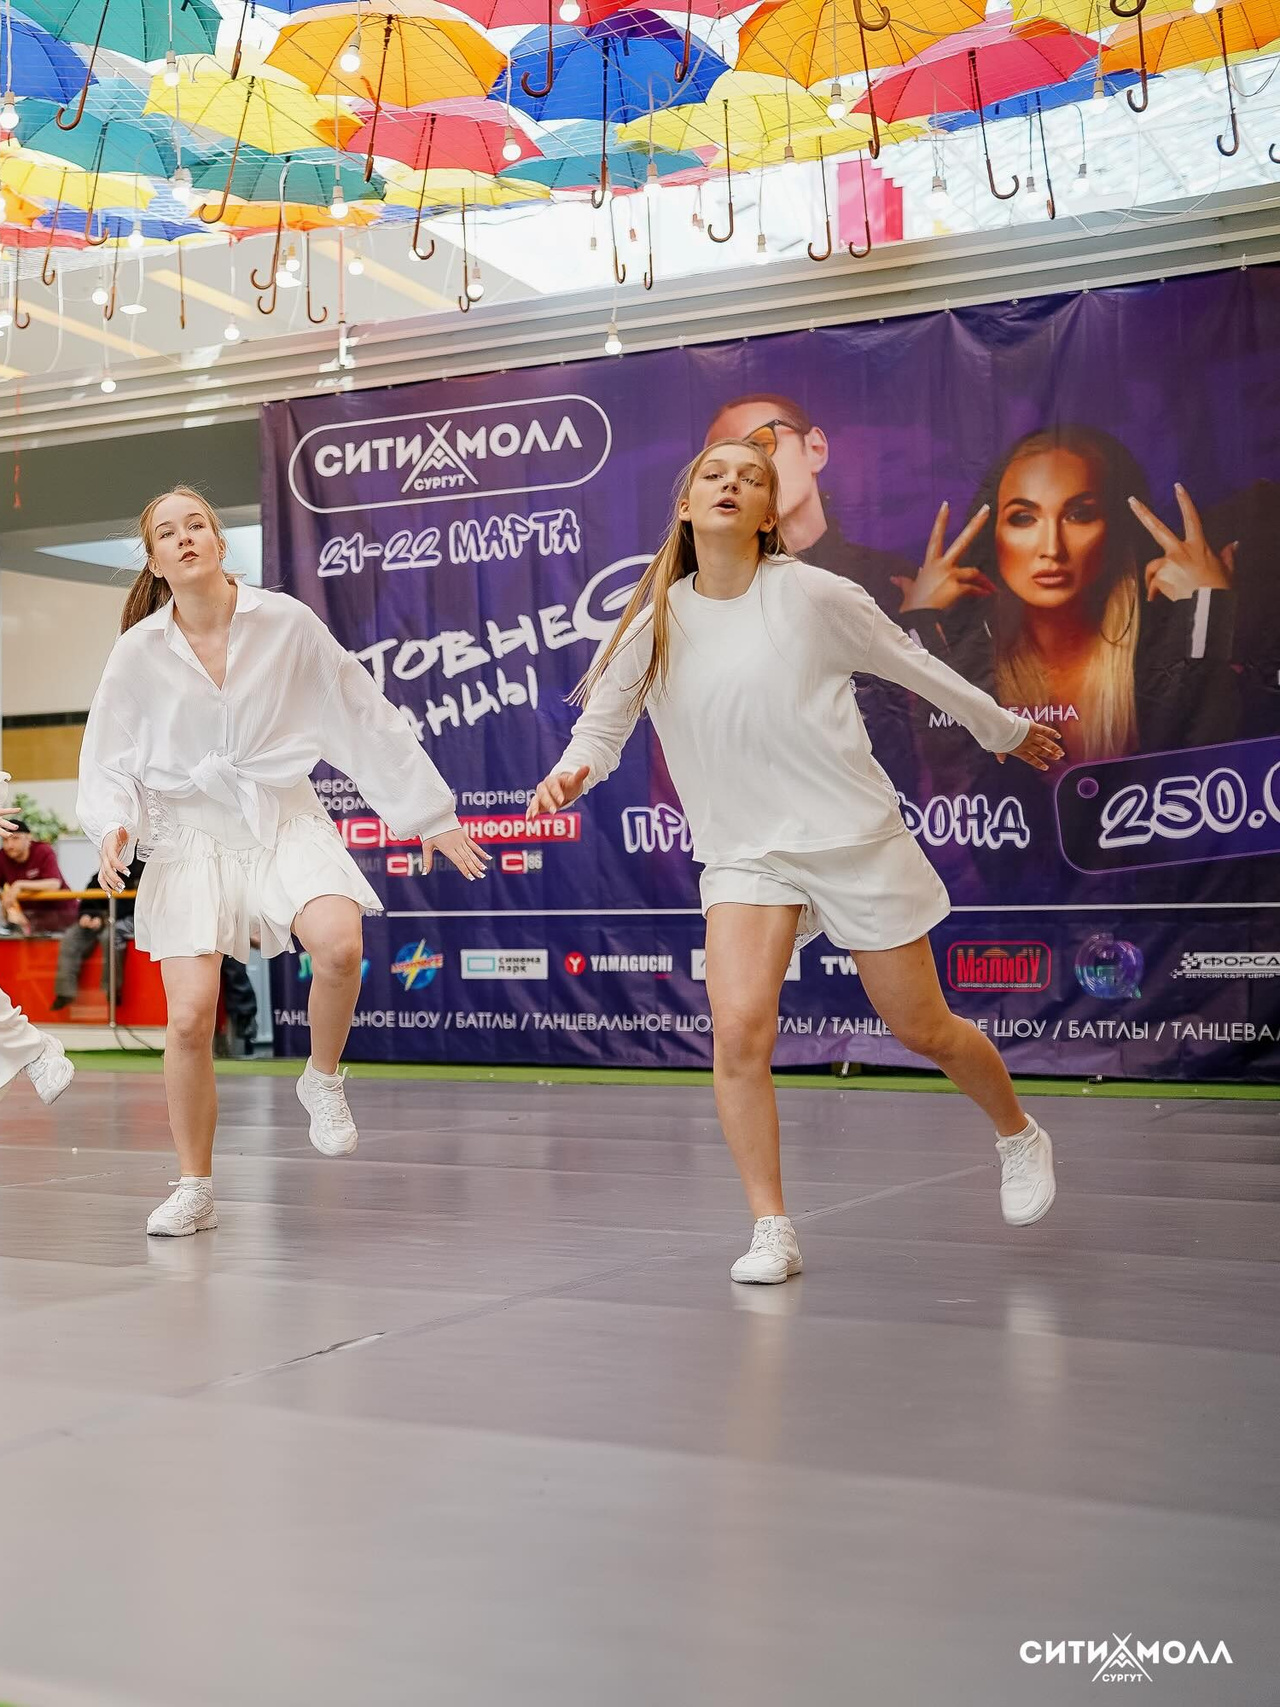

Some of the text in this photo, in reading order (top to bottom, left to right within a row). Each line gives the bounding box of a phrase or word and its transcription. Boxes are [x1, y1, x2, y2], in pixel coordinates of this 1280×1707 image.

[314, 415, 583, 477] СИТИ МОЛЛ
[413, 473, 466, 491] СУРГУТ
[317, 508, 581, 578] 21-22 МАРТА
[349, 605, 578, 694] ТОВЫЕ
[498, 965, 527, 975] парк
[589, 954, 673, 972] YAMAGUCHI
[1203, 956, 1280, 967] ФОРСА
[398, 1011, 441, 1029] ШОУ
[455, 1011, 517, 1030] БАТТЛЫ
[533, 1012, 671, 1034] ТАНЦЕВАЛЬНОЕ
[675, 1014, 714, 1033] ШО
[993, 1018, 1047, 1038] ШОУ
[1068, 1018, 1149, 1041] БАТТЛЫ
[1170, 1021, 1280, 1043] ТАНЦЕВА
